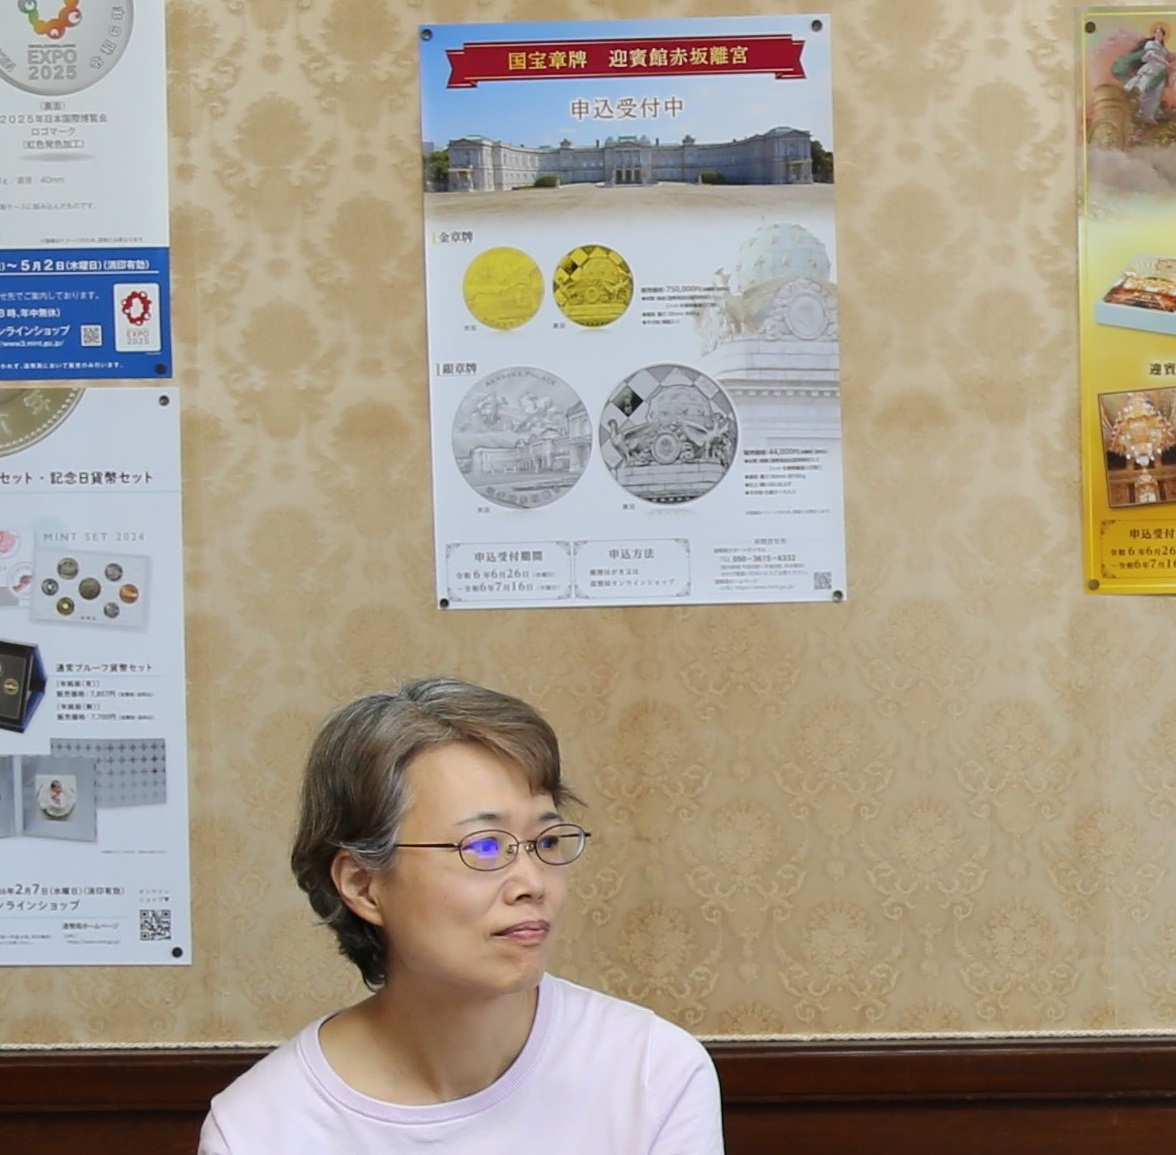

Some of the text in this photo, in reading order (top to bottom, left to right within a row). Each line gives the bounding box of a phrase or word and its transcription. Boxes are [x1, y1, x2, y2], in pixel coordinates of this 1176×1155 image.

[27, 49, 78, 65] EXPO
[508, 45, 749, 71] 国宝章牌 迎賓館赤坂離宮
[28, 65, 78, 80] 2025
[570, 96, 684, 120] 申込受付中
[43, 532, 145, 542] MINT SET 2024
[474, 550, 543, 562] 申込受付期間
[609, 548, 655, 560] 申込方法
